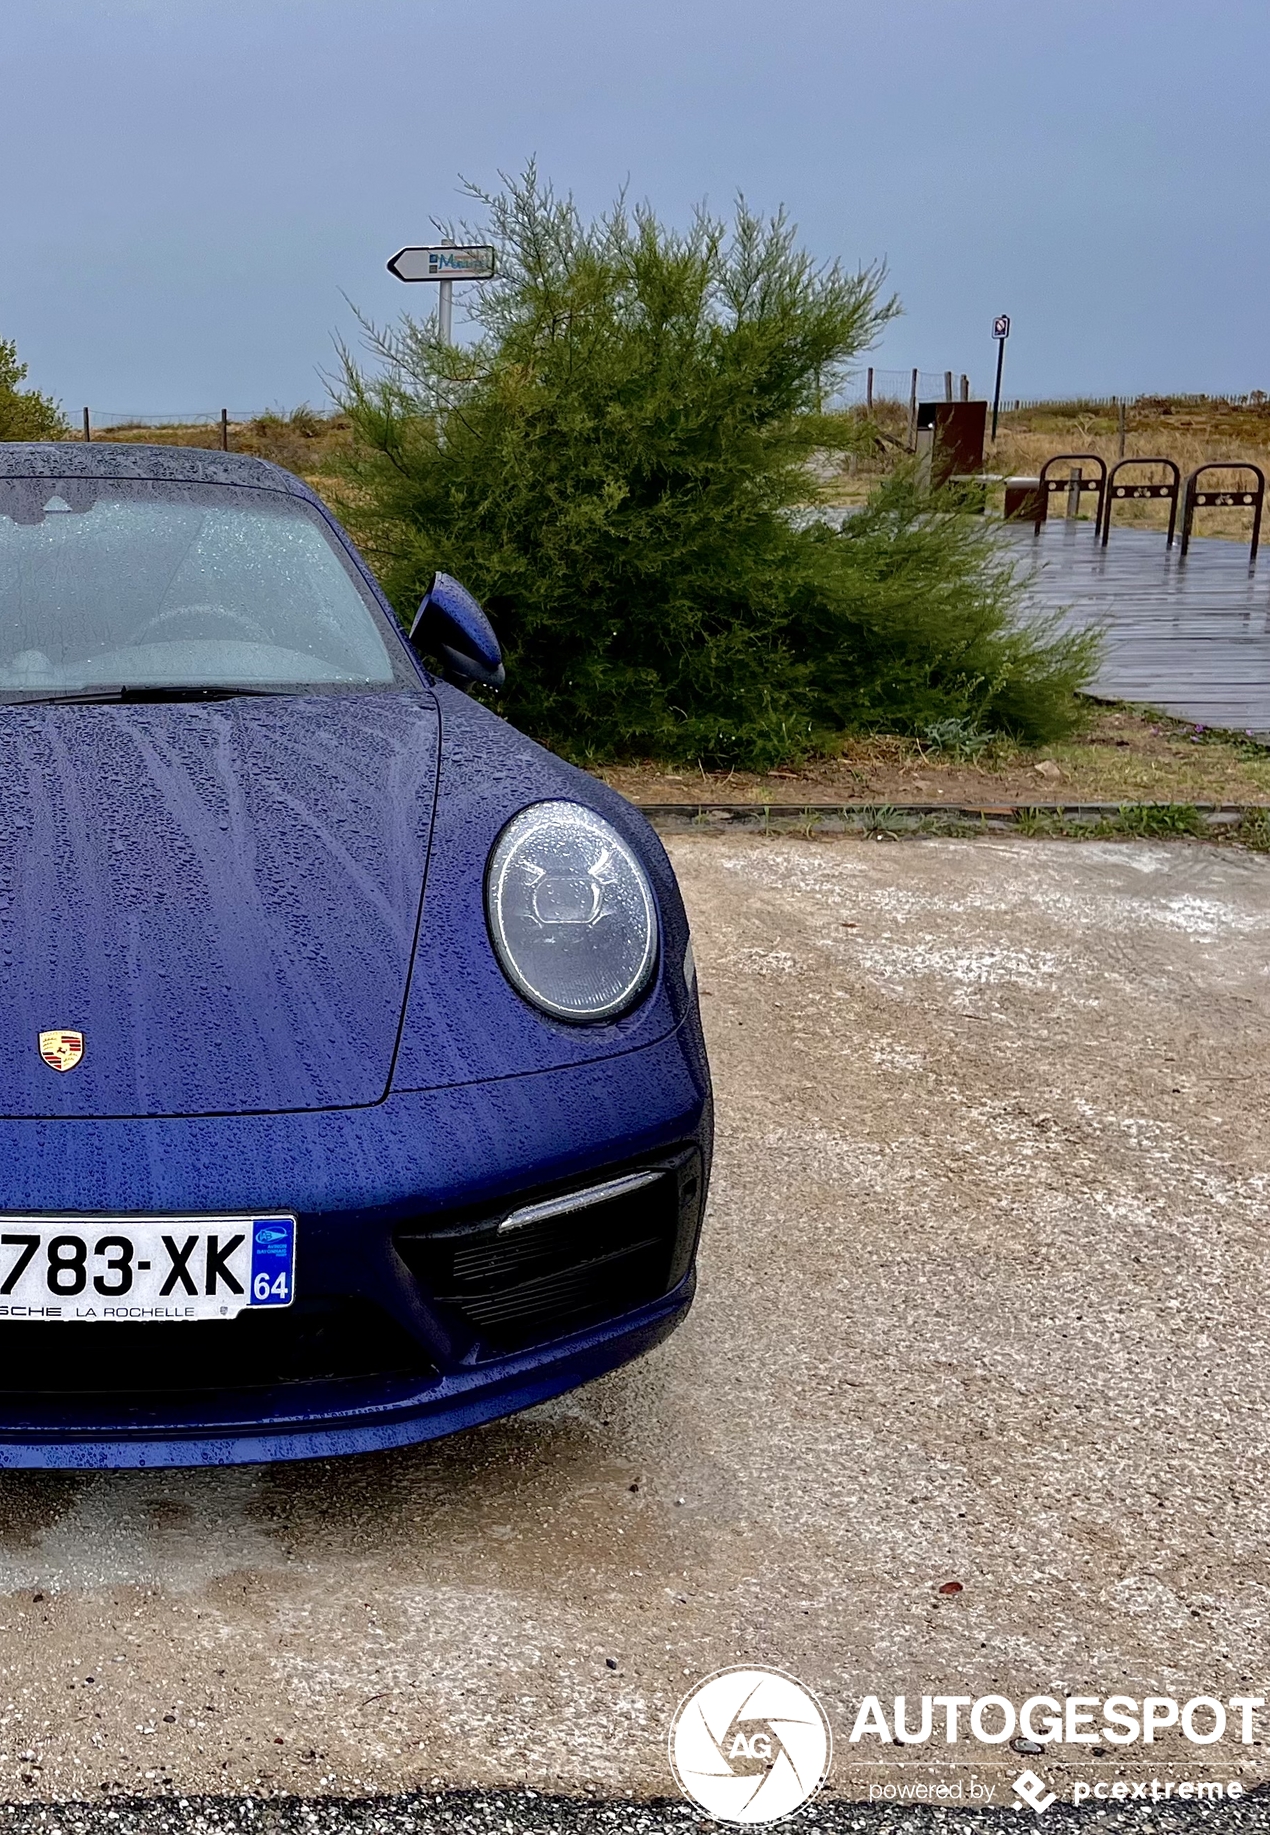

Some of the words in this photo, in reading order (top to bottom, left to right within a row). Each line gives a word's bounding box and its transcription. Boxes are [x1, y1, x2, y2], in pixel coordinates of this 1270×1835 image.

[254, 1271, 289, 1300] 64
[76, 1306, 96, 1318] LA
[103, 1305, 195, 1318] ROCHELLE
